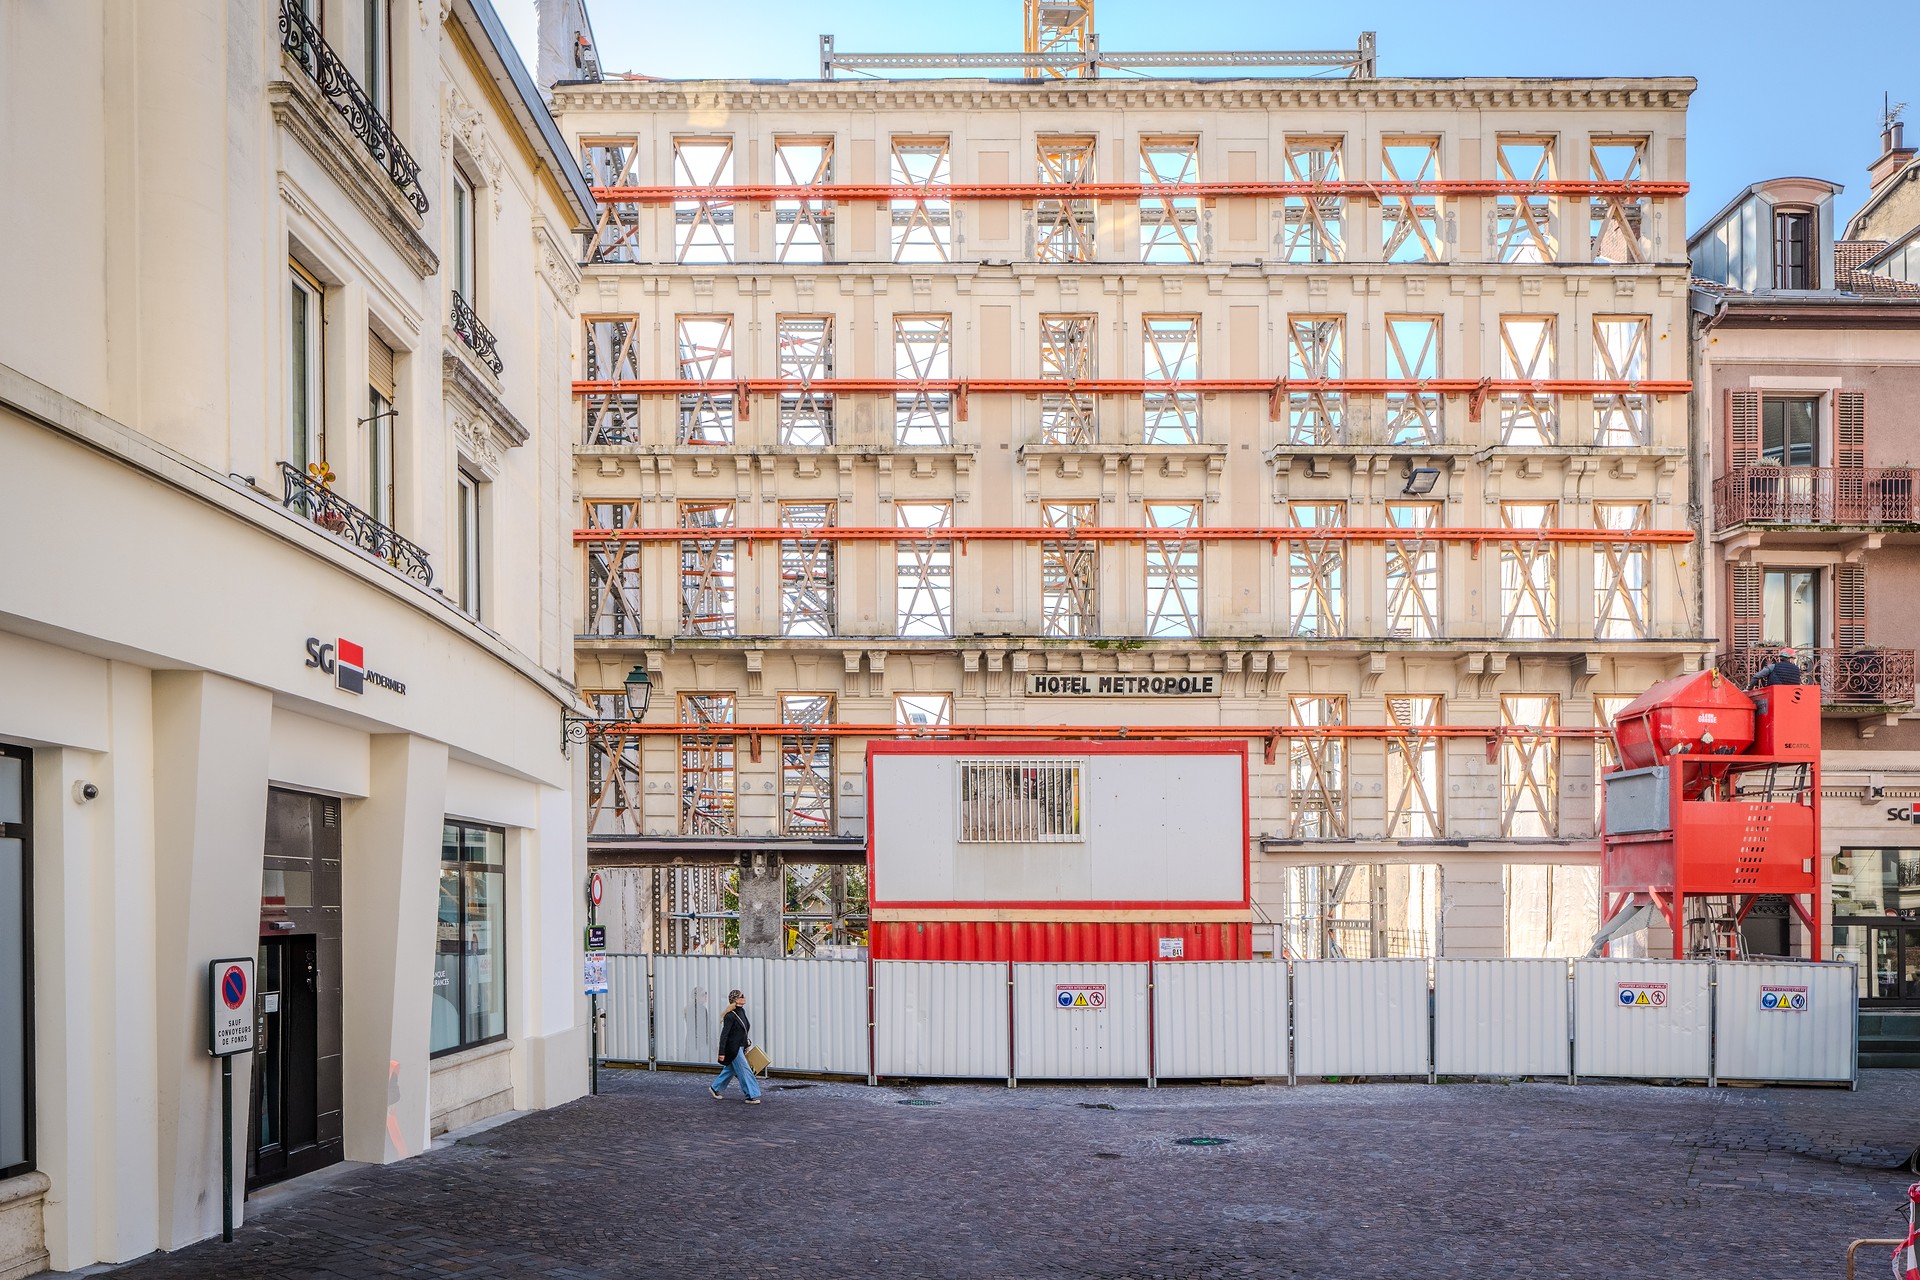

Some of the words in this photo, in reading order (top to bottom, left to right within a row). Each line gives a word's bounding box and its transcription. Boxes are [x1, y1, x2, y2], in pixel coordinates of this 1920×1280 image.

[305, 637, 335, 675] SG
[1035, 676, 1091, 693] HOTEL
[1099, 676, 1213, 694] METROPOLE
[1887, 807, 1910, 821] SG
[228, 1019, 241, 1027] SAUF
[218, 1026, 251, 1037] CONVOYEURS
[231, 1035, 248, 1044] FONDS
